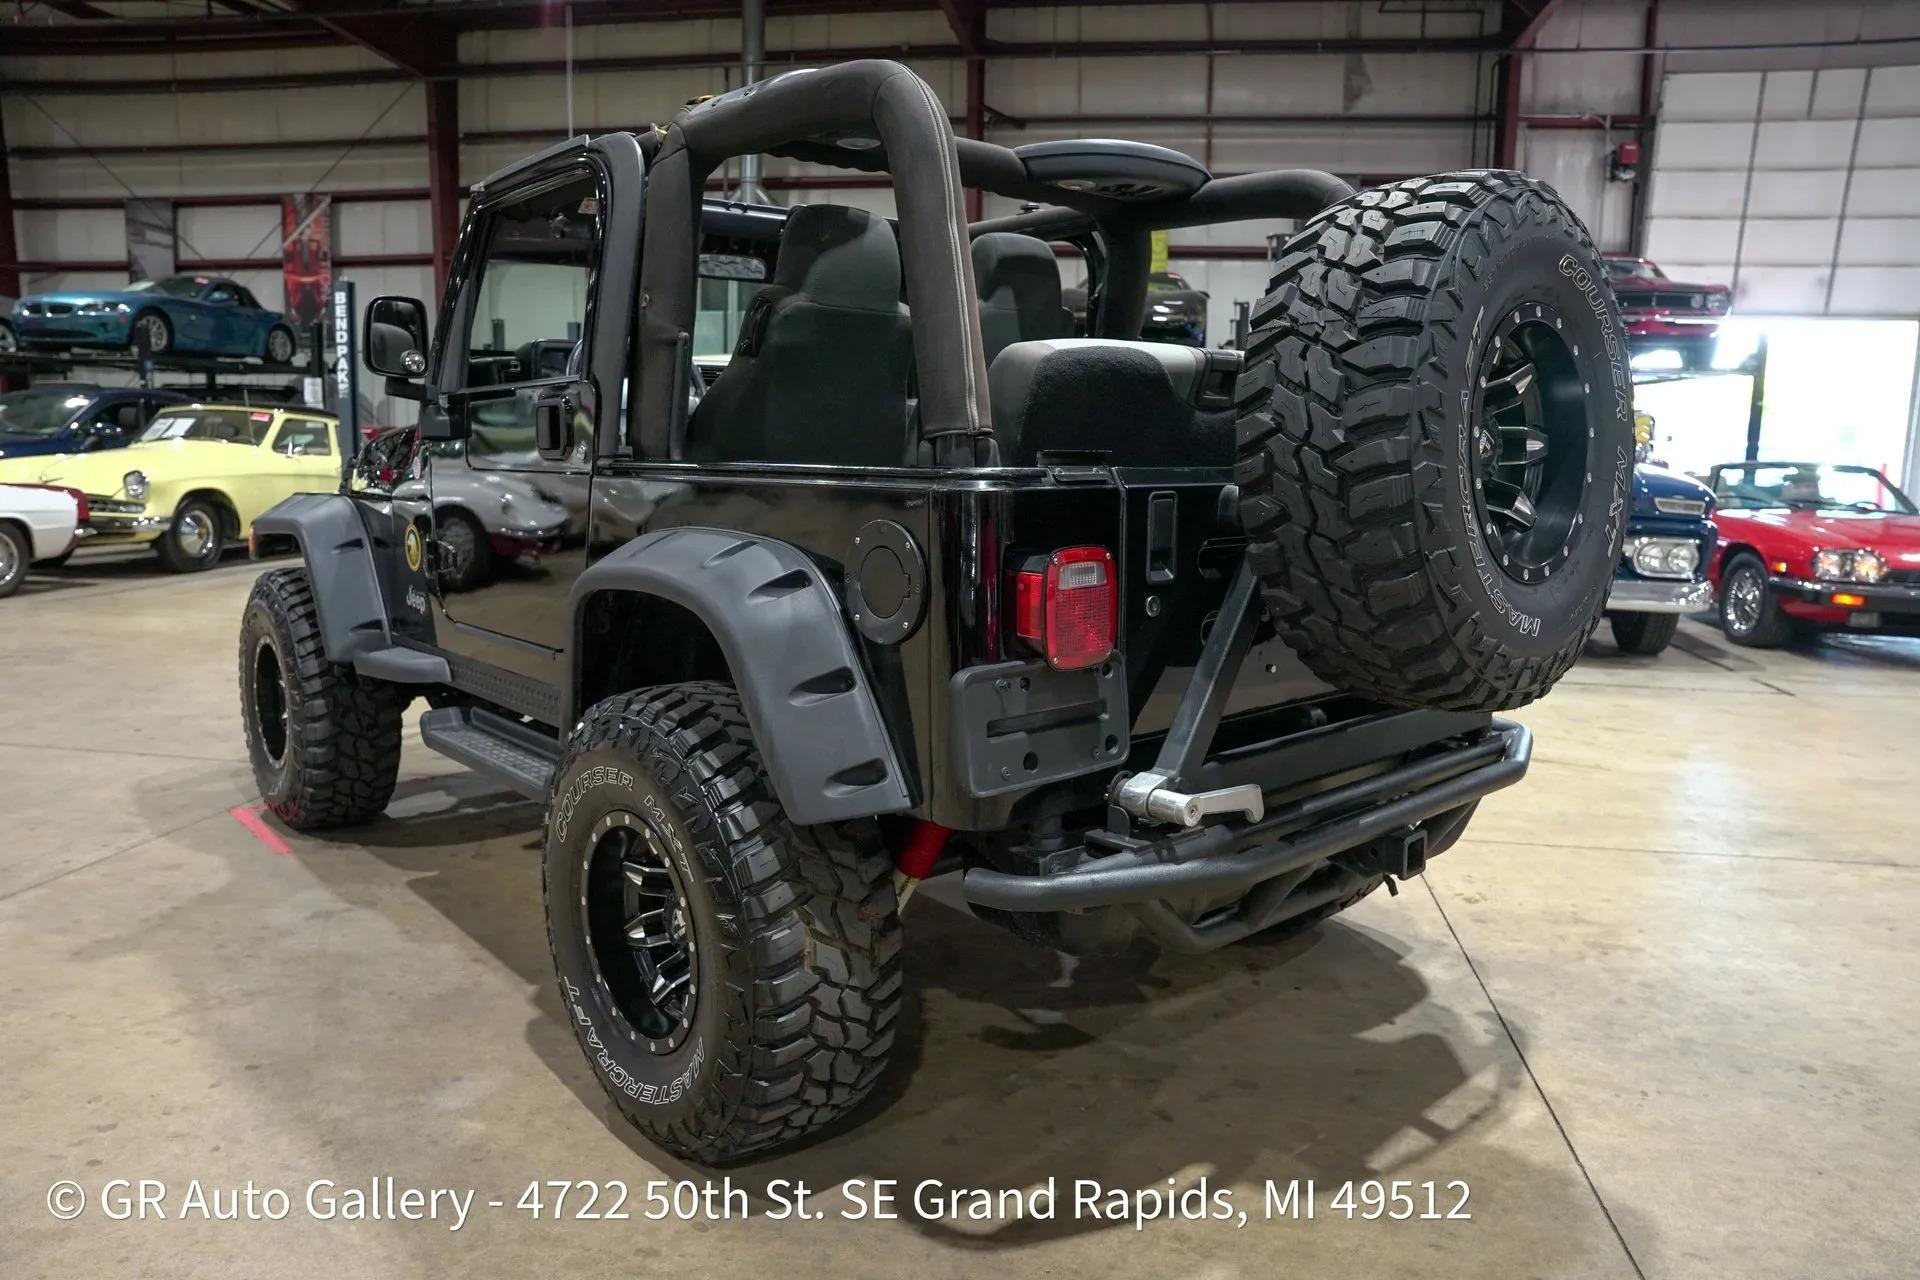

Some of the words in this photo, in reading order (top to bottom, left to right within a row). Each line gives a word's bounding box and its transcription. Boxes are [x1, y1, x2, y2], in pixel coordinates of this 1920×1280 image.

[1558, 254, 1628, 422] COURSER
[1605, 445, 1628, 559] MXT
[1458, 306, 1540, 637] MASTERCRAFT
[406, 584, 426, 615] Jeep
[555, 766, 634, 843] COURSER
[643, 794, 694, 883] MXT
[564, 976, 705, 1105] MASTERCRAFT
